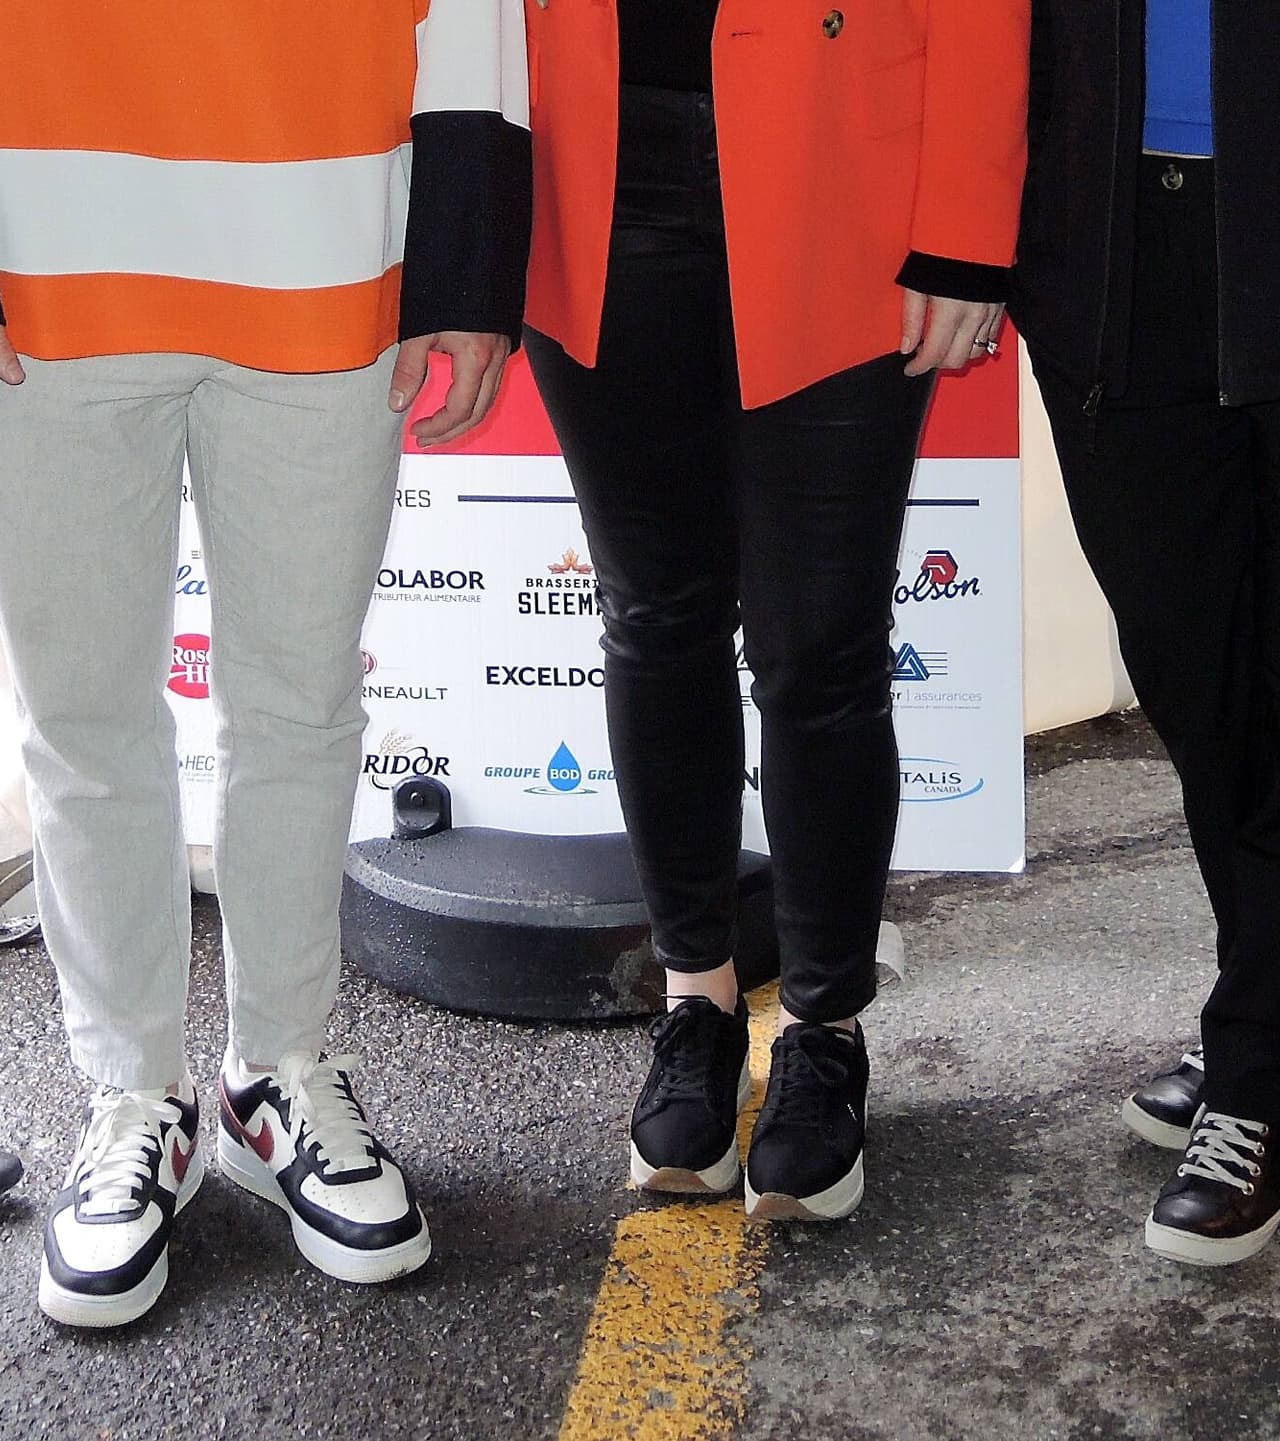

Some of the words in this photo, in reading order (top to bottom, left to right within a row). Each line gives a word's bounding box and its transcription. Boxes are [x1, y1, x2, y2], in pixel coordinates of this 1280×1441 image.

[377, 569, 485, 590] OLABOR
[424, 594, 480, 602] ALIMENTAIRE
[518, 592, 602, 616] SLEEM
[486, 666, 605, 687] EXCELDO
[913, 692, 982, 702] assurances
[363, 754, 450, 777] RIDOR
[484, 766, 541, 779] GROUPE
[549, 768, 580, 780] BOD
